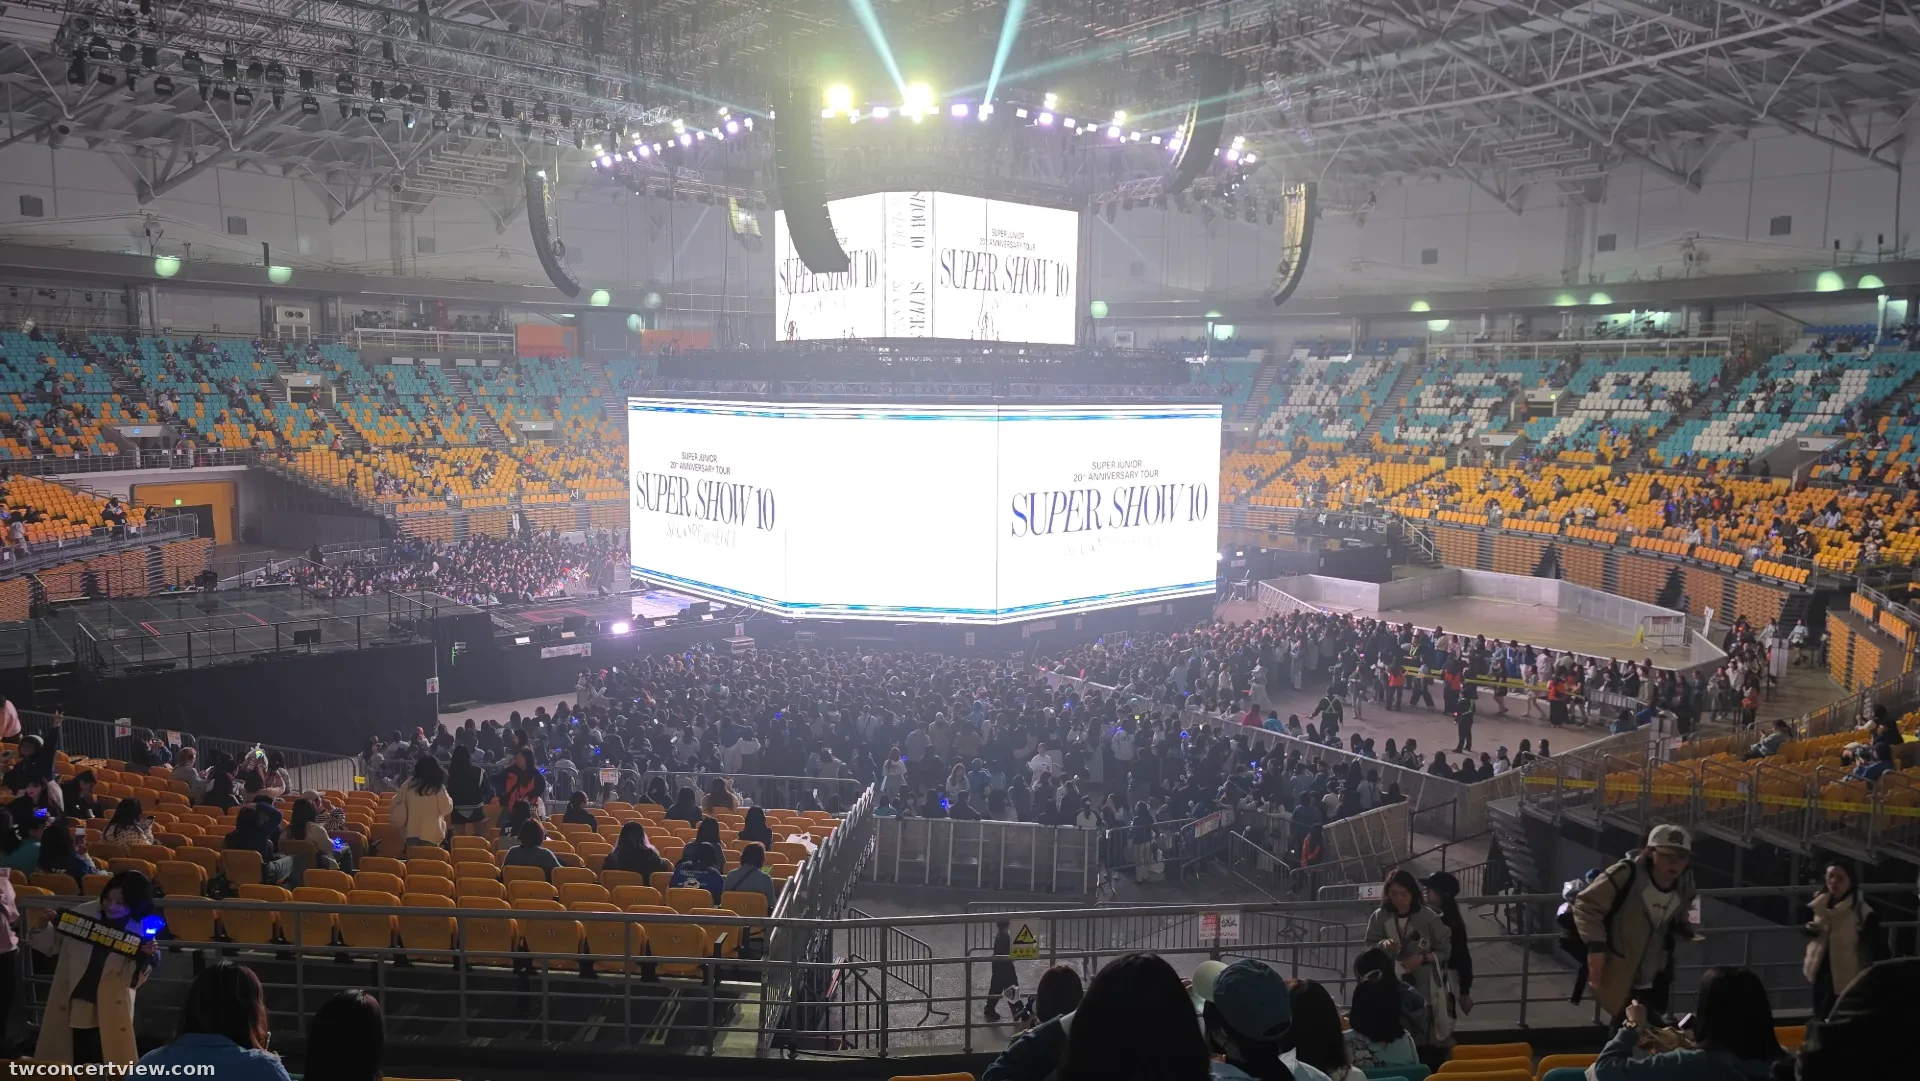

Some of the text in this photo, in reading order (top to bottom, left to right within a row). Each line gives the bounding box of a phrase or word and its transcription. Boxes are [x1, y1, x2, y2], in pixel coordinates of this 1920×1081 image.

[940, 247, 1070, 299] SUPER SHOW 10
[681, 451, 718, 463] SUPER JUNIOR
[679, 461, 715, 473] ANNIVERSARY
[715, 465, 731, 475] TOUR
[1091, 459, 1142, 470] SUPER JUNIOR
[1088, 471, 1139, 481] ANNIVERSARY
[1140, 469, 1159, 479] TOUR
[636, 470, 775, 532] SUPER SHOW 10
[1011, 482, 1208, 538] SUPER SHOW 10
[1367, 887, 1373, 896] S
